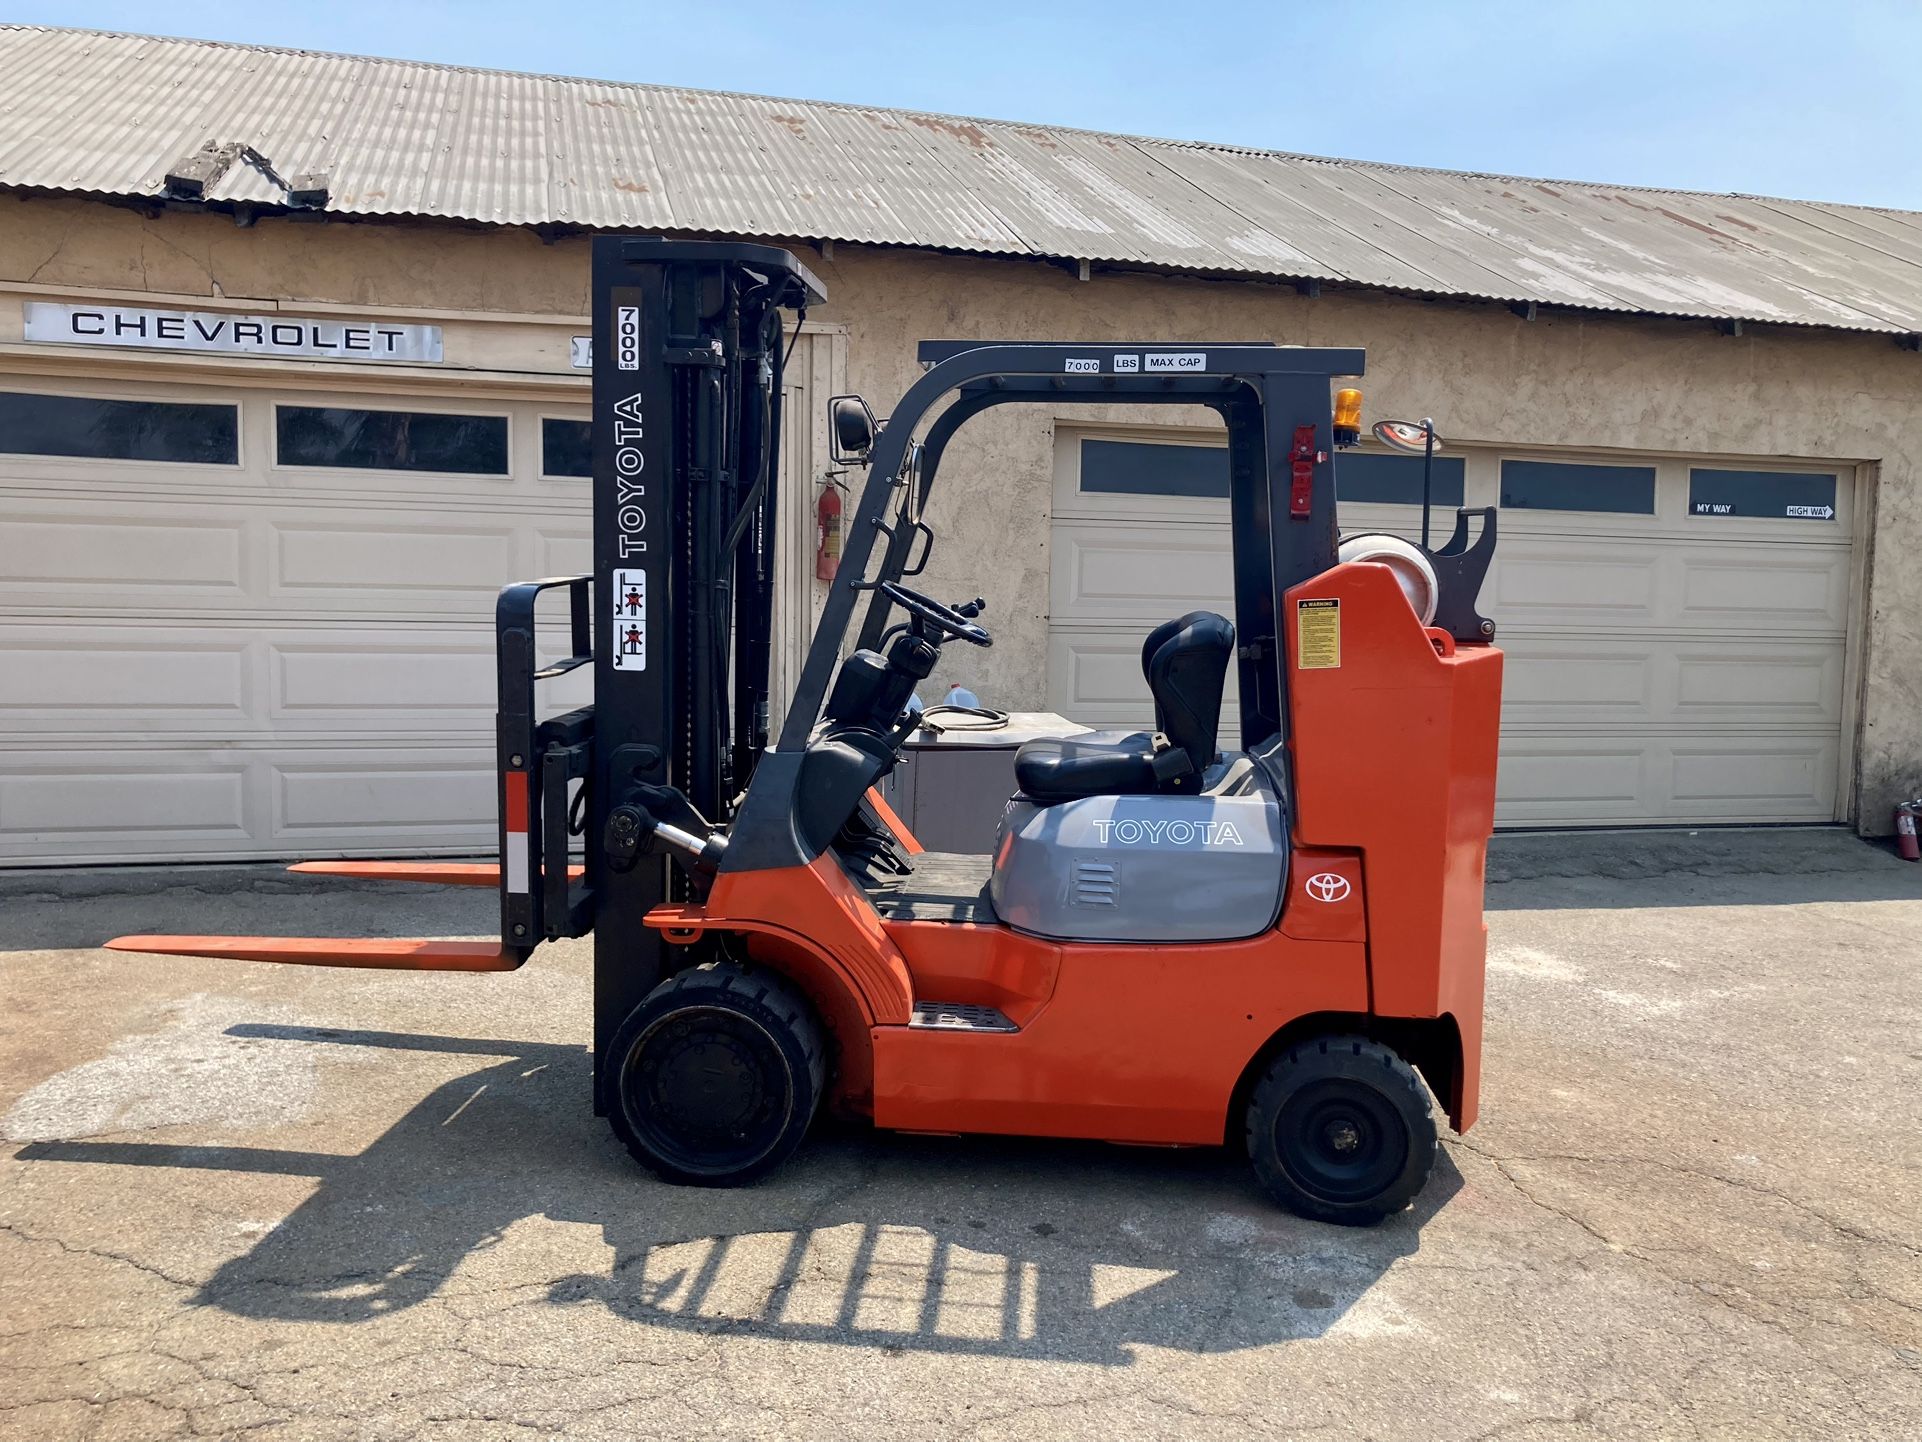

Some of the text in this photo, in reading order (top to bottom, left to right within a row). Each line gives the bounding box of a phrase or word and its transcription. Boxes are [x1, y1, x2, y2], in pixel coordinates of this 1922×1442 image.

[70, 311, 405, 353] CHEVROLET
[620, 308, 636, 363] 7000
[1067, 358, 1201, 371] 7000 LBS MAX CAP
[613, 392, 648, 559] TOYOTA
[1696, 503, 1732, 514] MY WAY
[1788, 506, 1829, 516] HIGH WAY
[1092, 819, 1244, 845] TOYOTA
